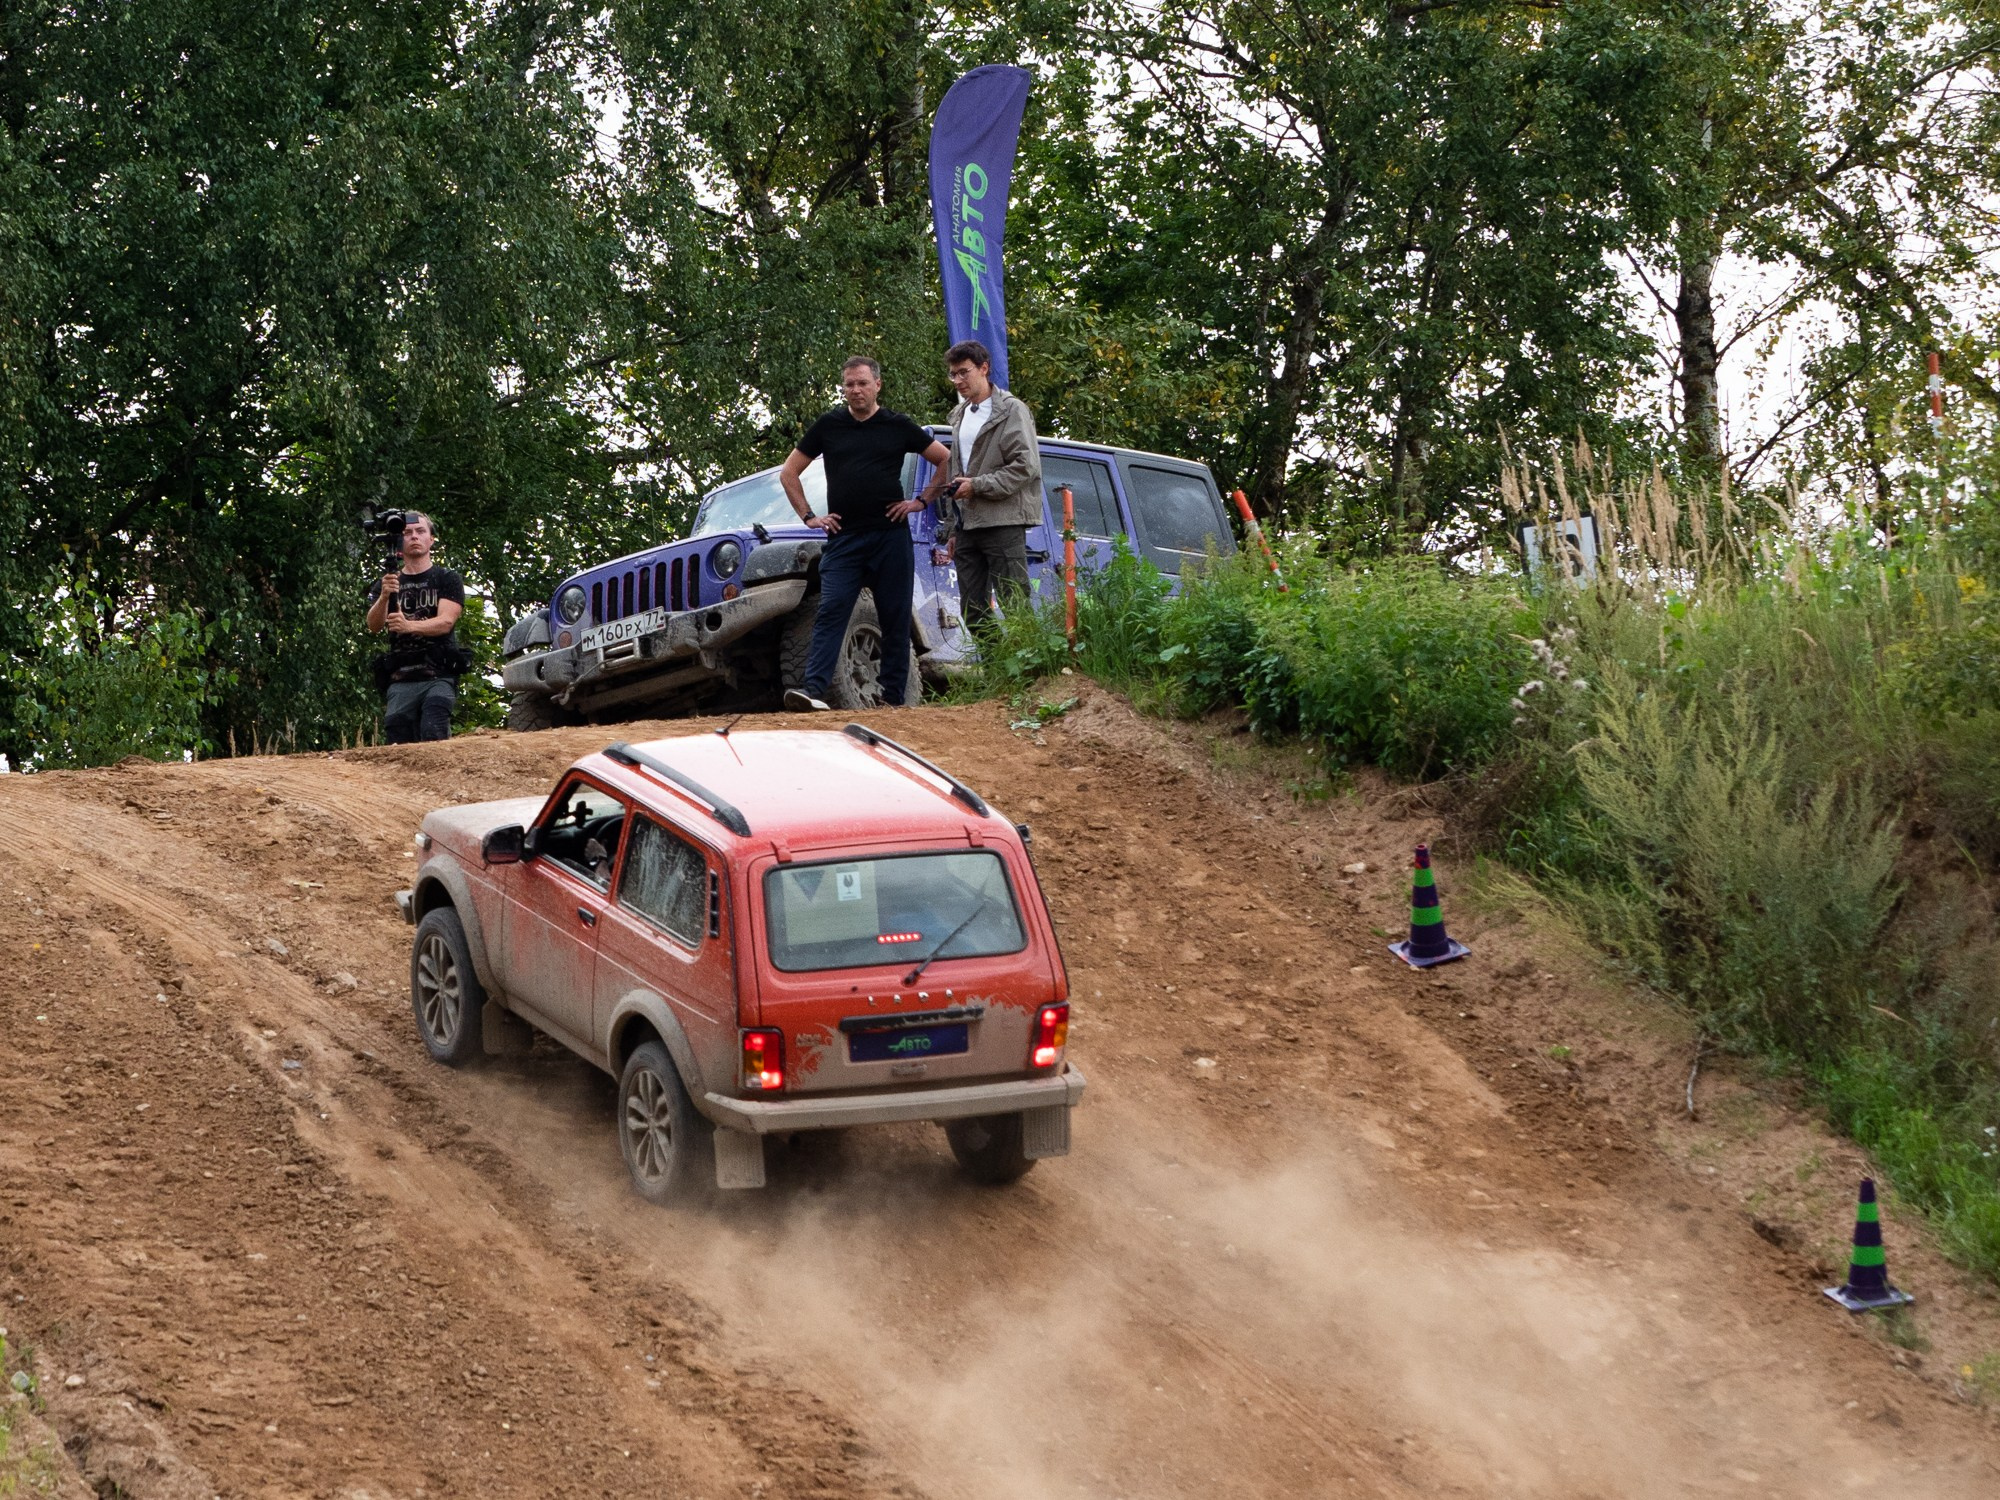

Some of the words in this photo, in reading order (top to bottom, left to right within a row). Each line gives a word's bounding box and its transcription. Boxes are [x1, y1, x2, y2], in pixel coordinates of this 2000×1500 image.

[952, 166, 963, 245] АНАТОМИЯ
[953, 162, 991, 331] АВТО
[888, 1036, 931, 1052] АВТО
